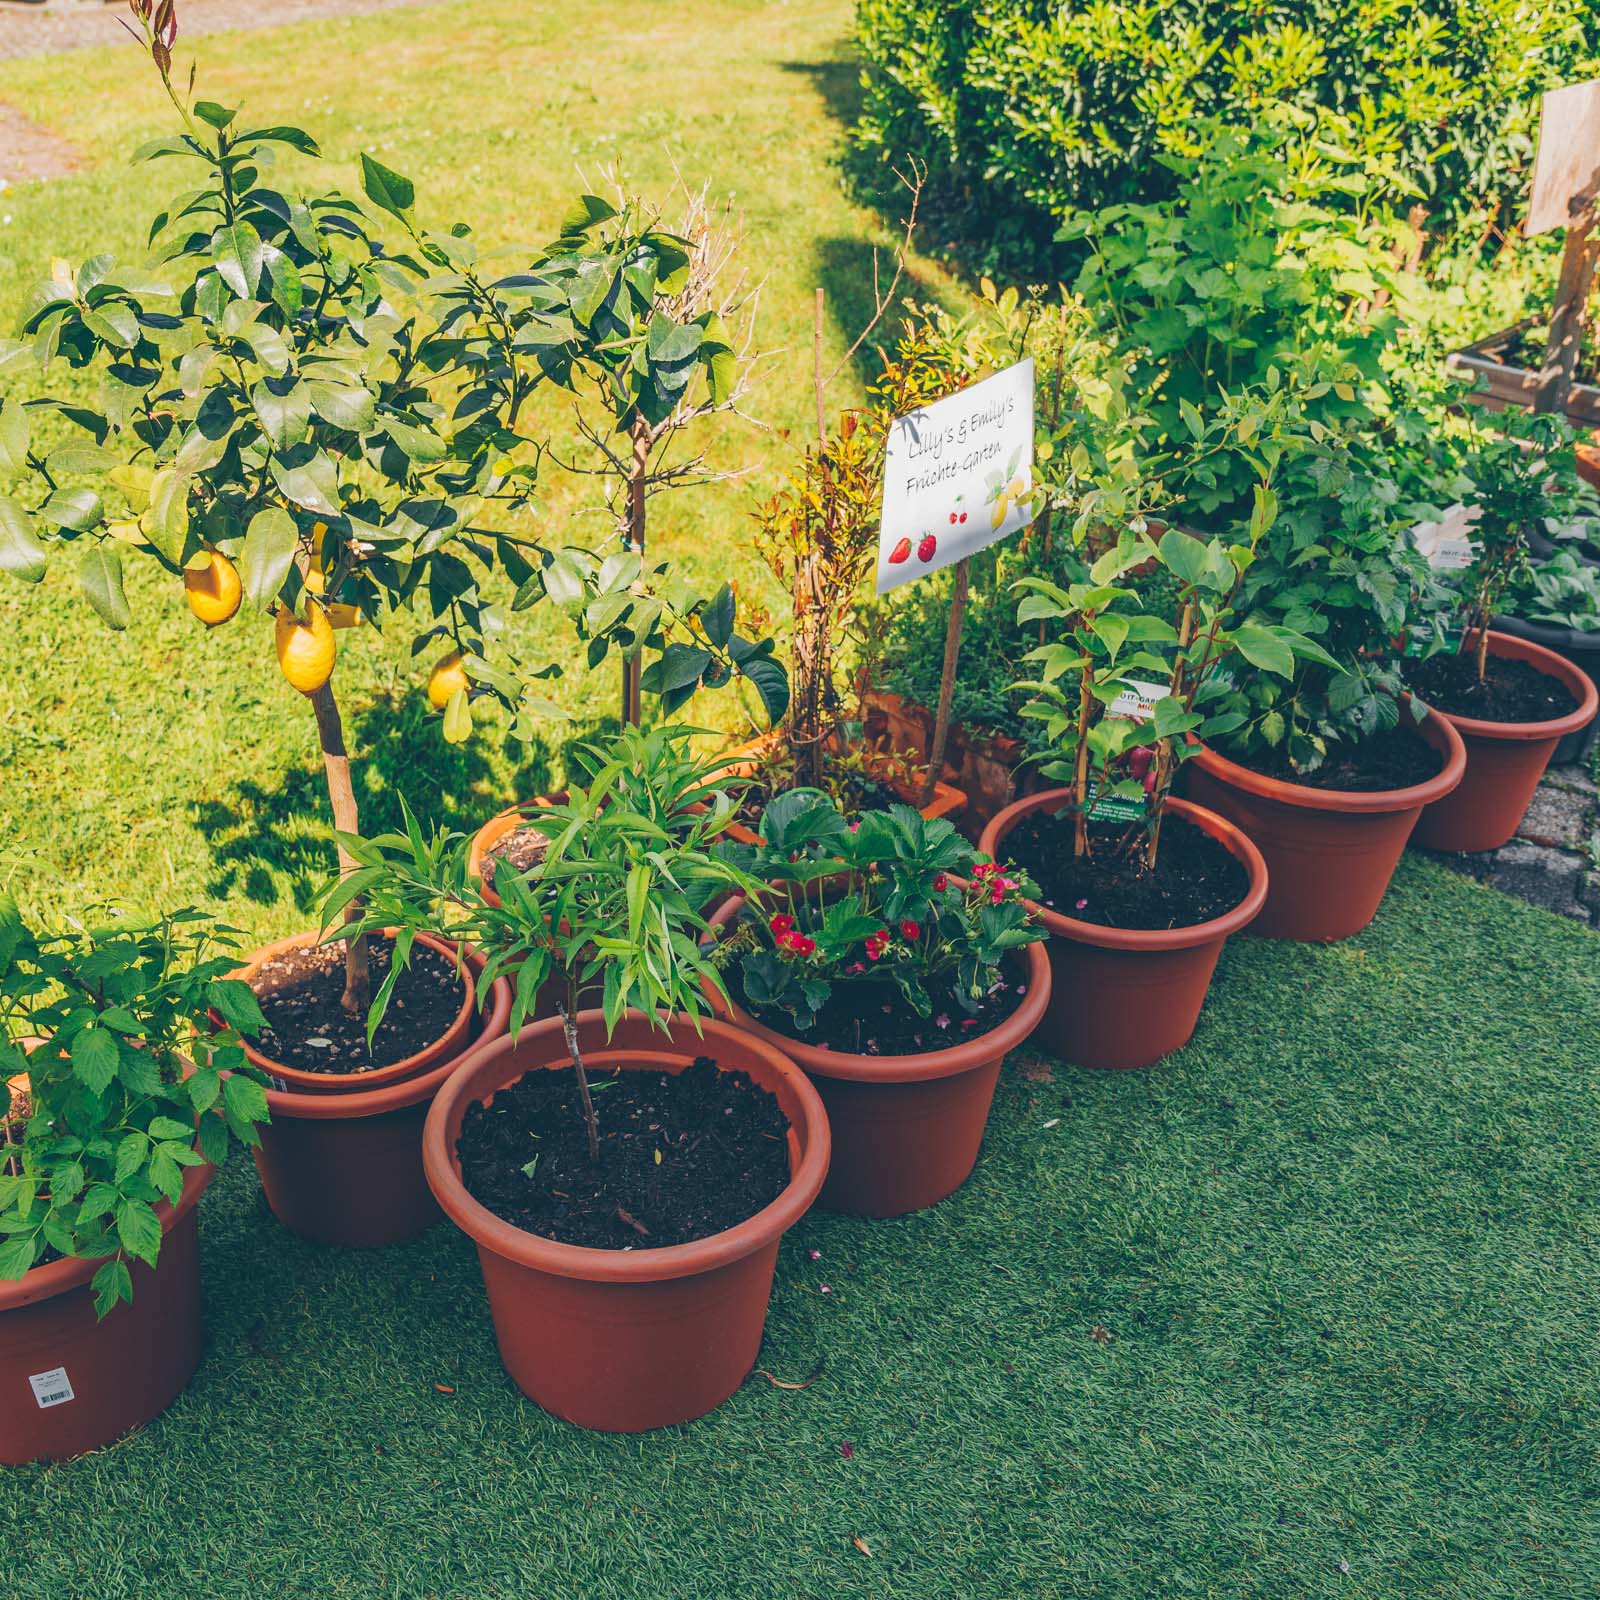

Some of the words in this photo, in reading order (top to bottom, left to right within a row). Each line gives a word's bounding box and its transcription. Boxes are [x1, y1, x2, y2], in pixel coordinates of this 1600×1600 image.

[908, 426, 954, 460] Lilly's
[957, 418, 967, 444] &
[970, 395, 1015, 432] Emily's
[906, 441, 1001, 496] Früchte-Garten
